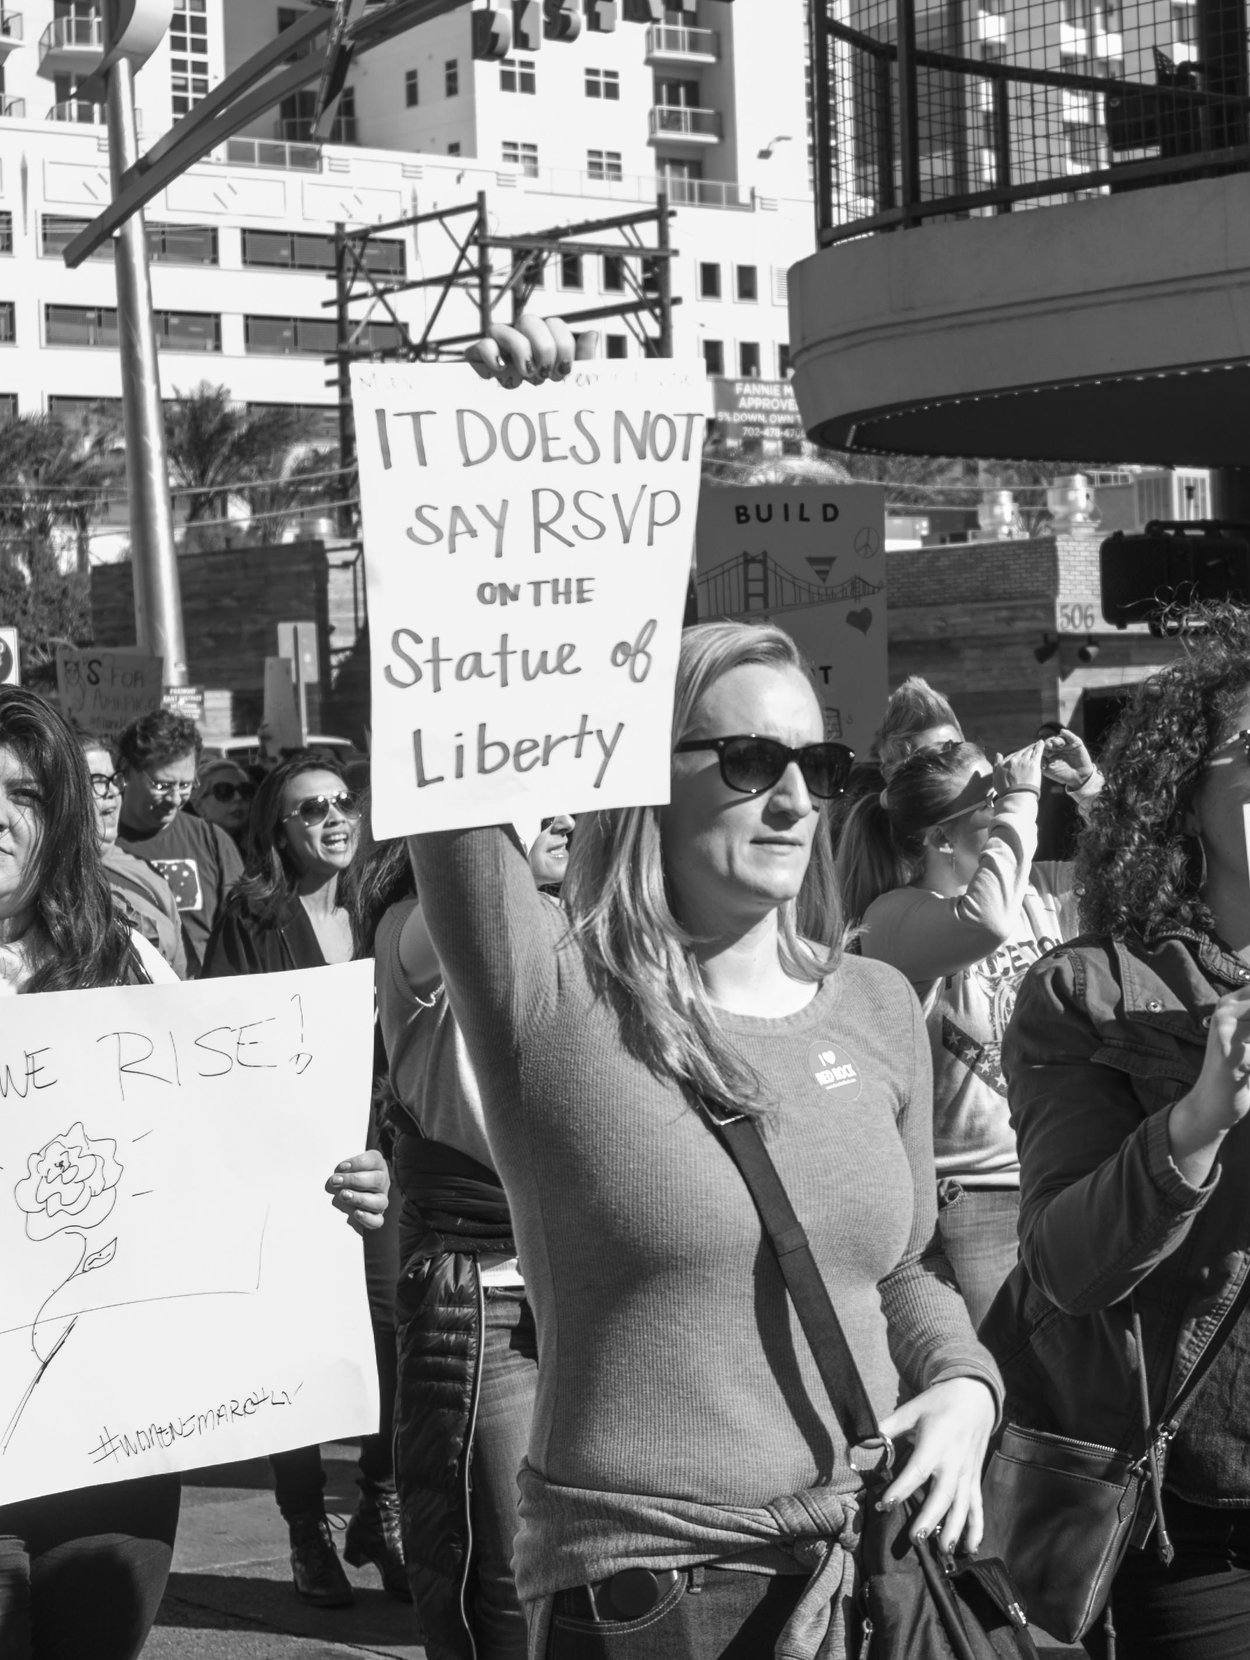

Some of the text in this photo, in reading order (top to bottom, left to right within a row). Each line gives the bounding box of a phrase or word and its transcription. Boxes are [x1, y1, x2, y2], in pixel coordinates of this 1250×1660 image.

[735, 382, 781, 396] FANNIE
[769, 413, 795, 424] OWN
[375, 408, 705, 470] IT DOES NOT
[406, 484, 681, 558] SAY RSVP
[735, 503, 839, 524] BUILD
[476, 577, 596, 606] ON THE
[1060, 603, 1095, 630] 506
[384, 619, 657, 693] Statue of
[413, 714, 625, 789] Liberty
